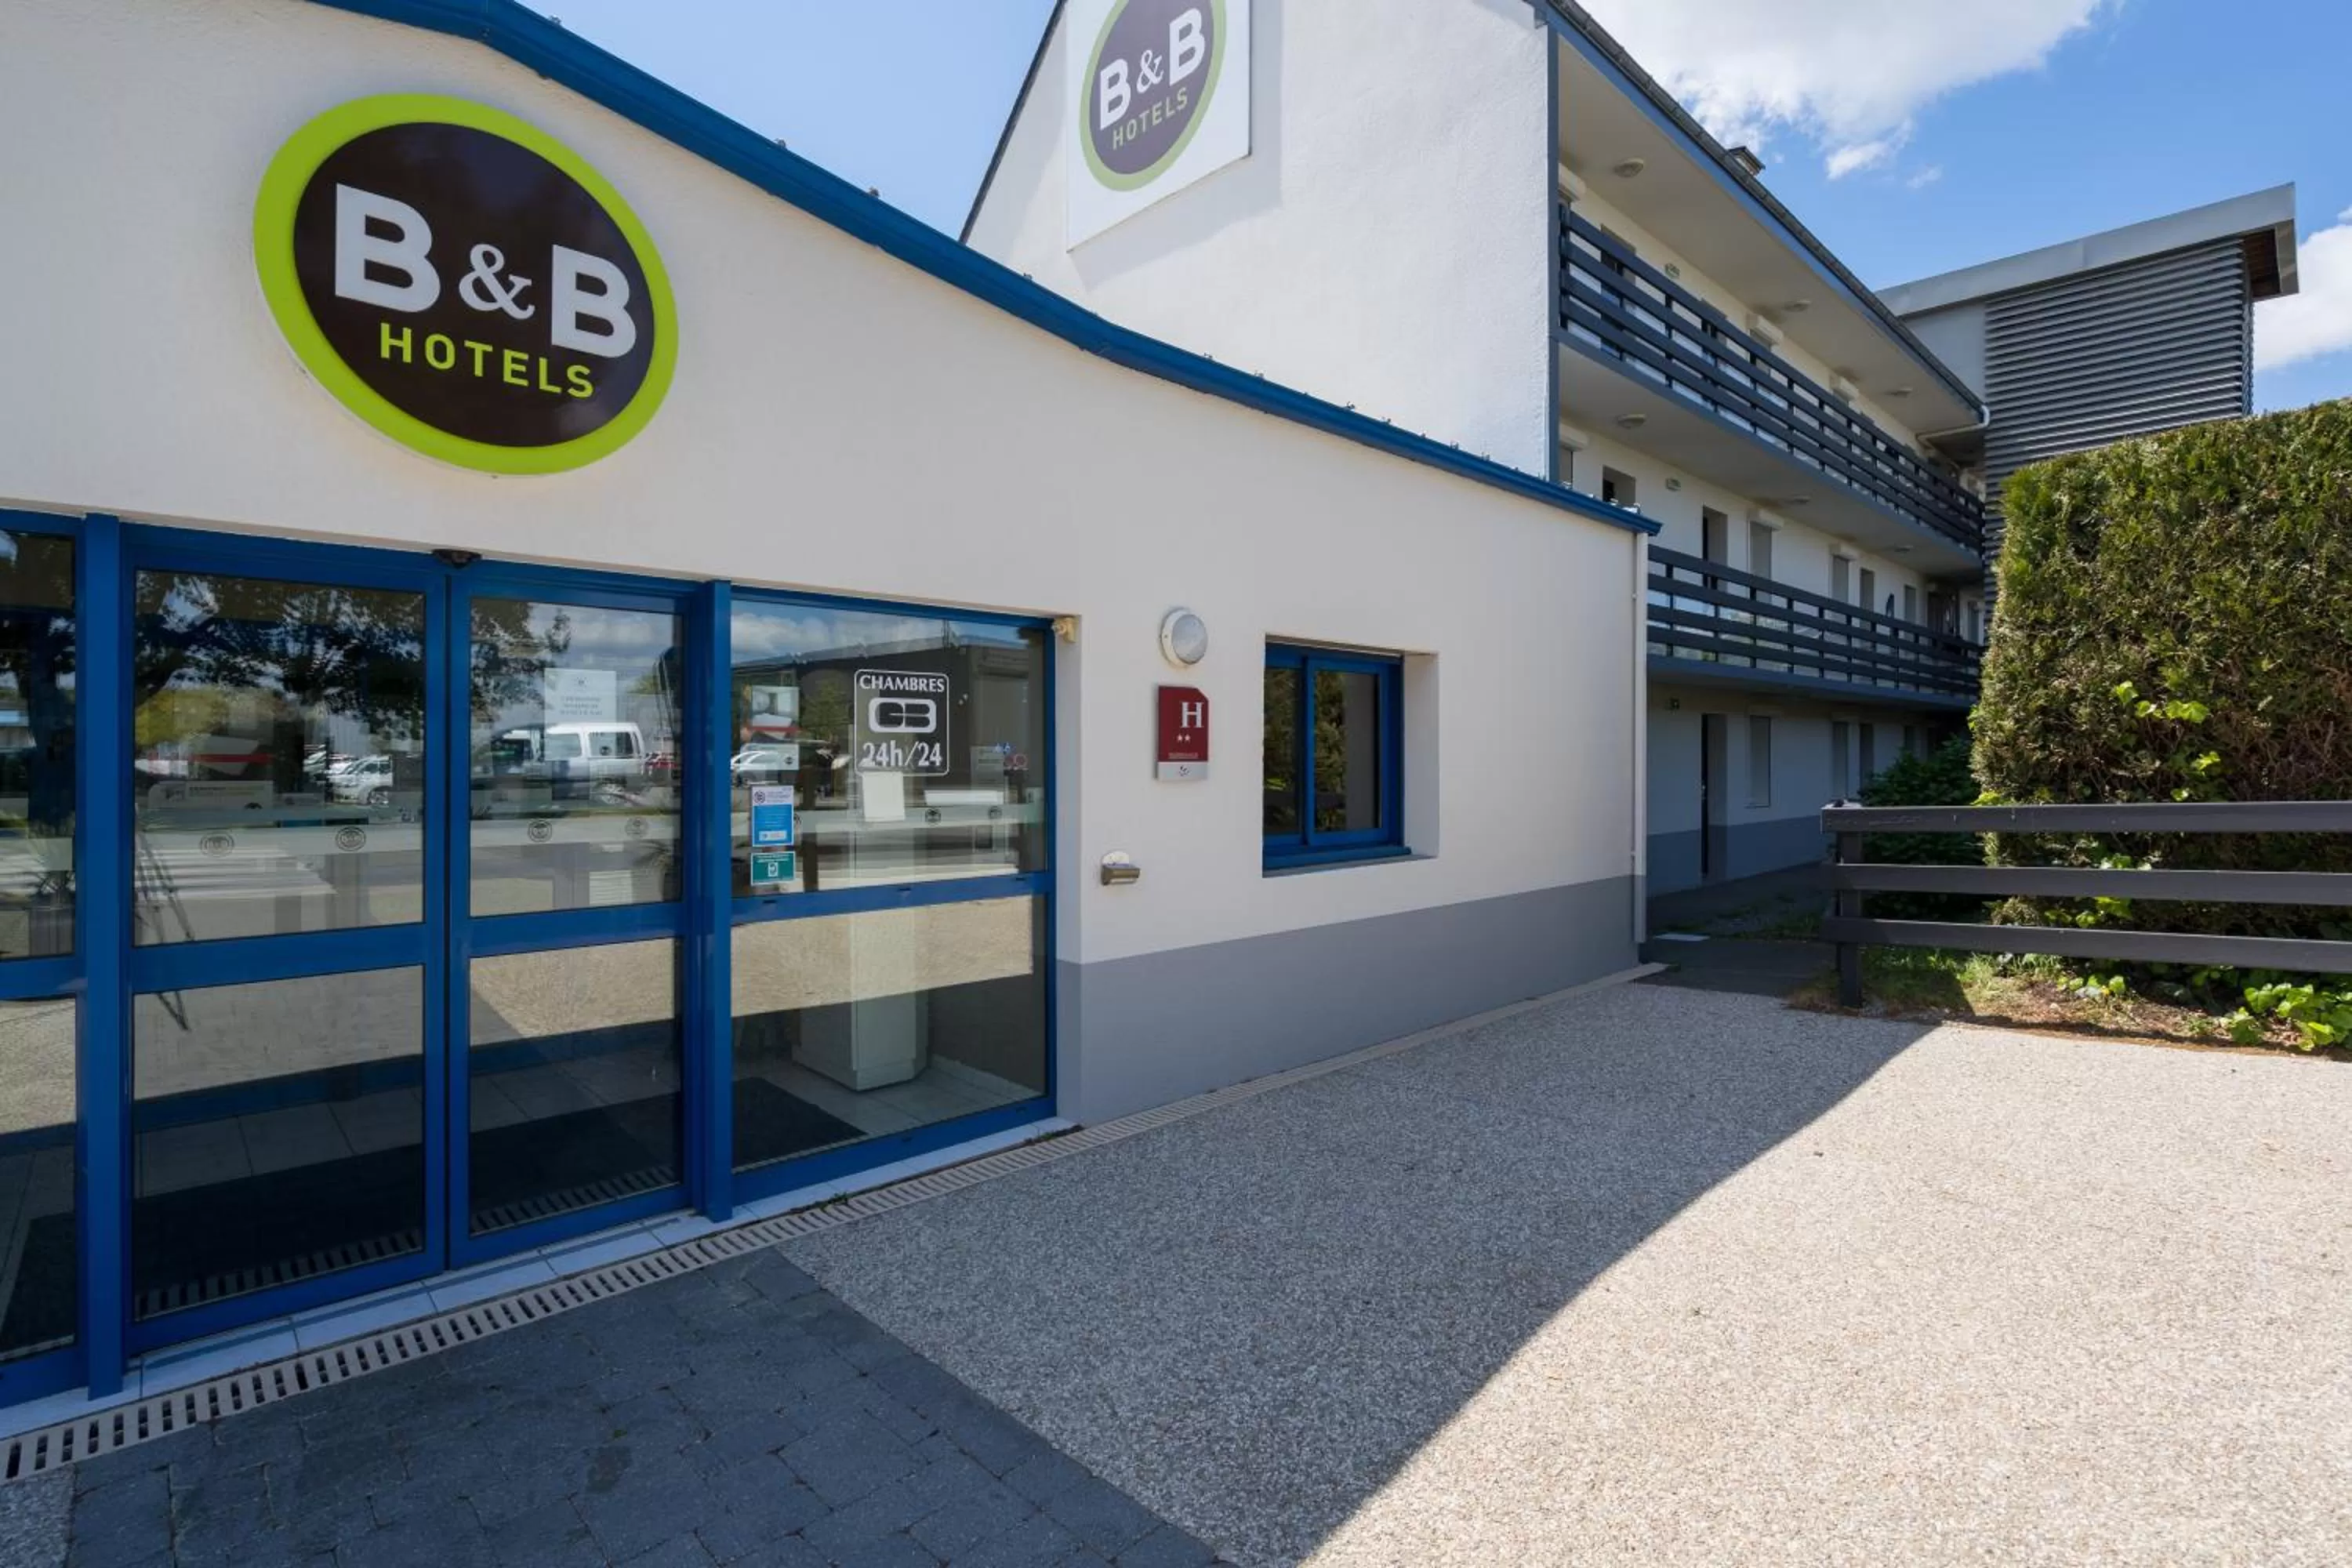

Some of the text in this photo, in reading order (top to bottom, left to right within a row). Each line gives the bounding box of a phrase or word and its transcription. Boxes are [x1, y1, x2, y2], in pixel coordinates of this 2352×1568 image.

[1100, 8, 1206, 131] B&B
[1112, 87, 1189, 151] HOTELS
[335, 183, 637, 359] B&B
[379, 322, 594, 399] HOTELS
[859, 674, 945, 692] CHAMBRES
[1180, 702, 1204, 728] H
[858, 739, 943, 768] 24h/24
